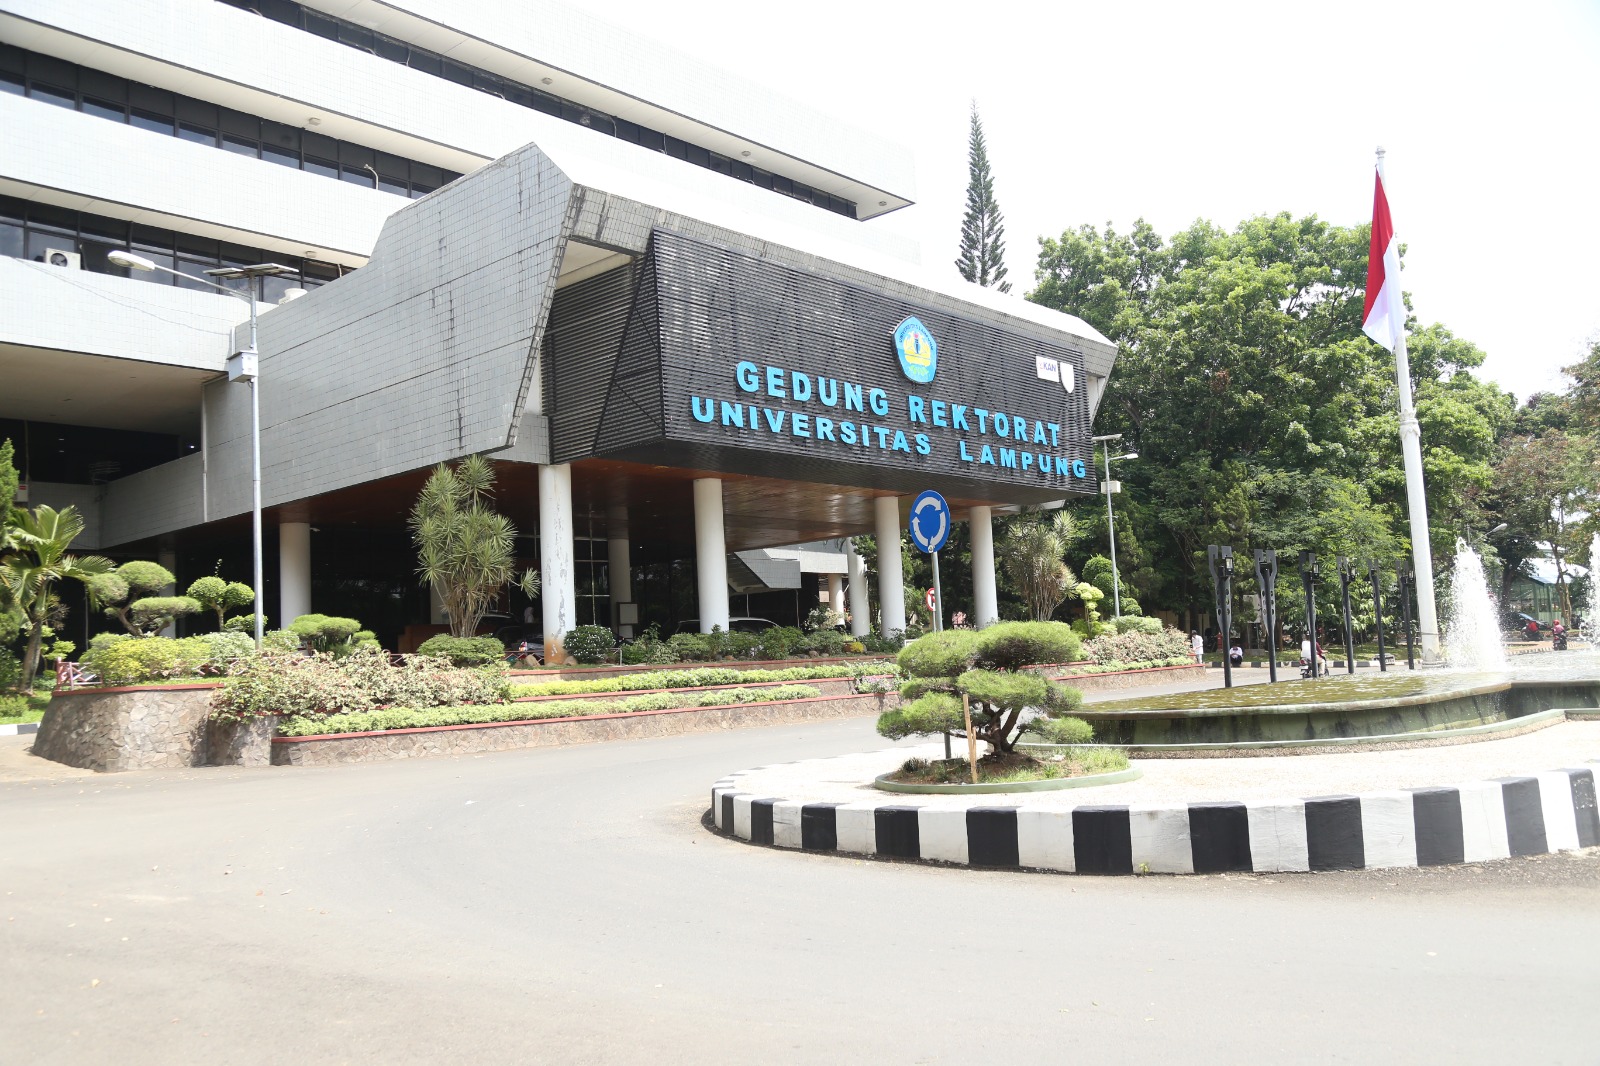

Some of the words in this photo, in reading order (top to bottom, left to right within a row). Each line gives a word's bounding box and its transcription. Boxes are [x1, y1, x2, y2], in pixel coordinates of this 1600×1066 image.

[735, 360, 890, 416] GEDUNG
[908, 394, 1060, 447] REKTORAT
[1043, 361, 1057, 372] KAN
[691, 395, 932, 456] UNIVERSITAS
[959, 440, 1087, 479] LAMPUNG
